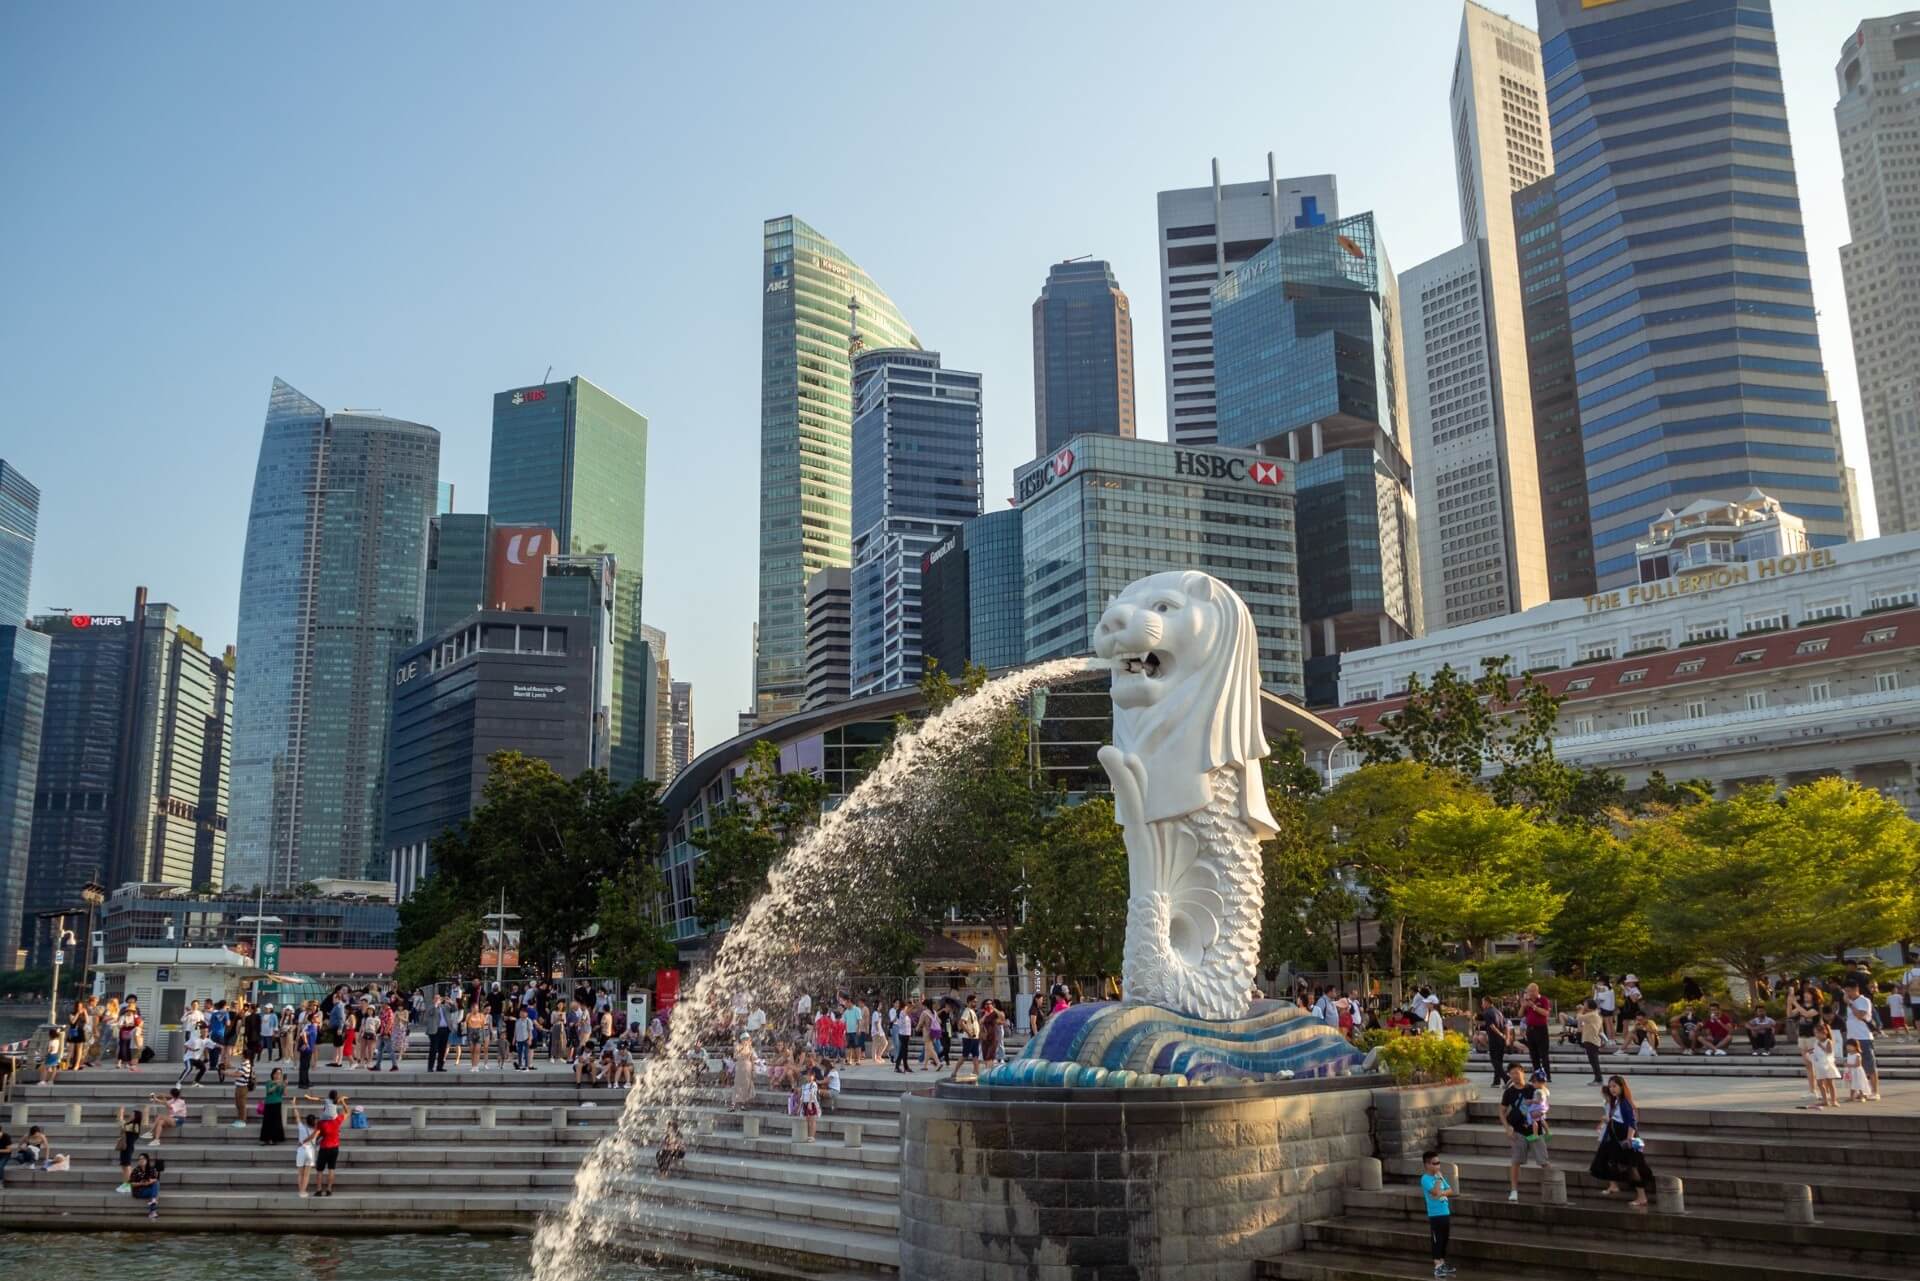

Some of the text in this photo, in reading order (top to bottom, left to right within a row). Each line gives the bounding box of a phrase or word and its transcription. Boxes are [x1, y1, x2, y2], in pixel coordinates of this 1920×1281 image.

[1175, 451, 1246, 481] HSBC
[1019, 460, 1054, 503] HSBC
[1583, 548, 1837, 613] THE FULLERTON HOTEL
[90, 617, 122, 626] MUFG
[396, 661, 417, 685] OUE
